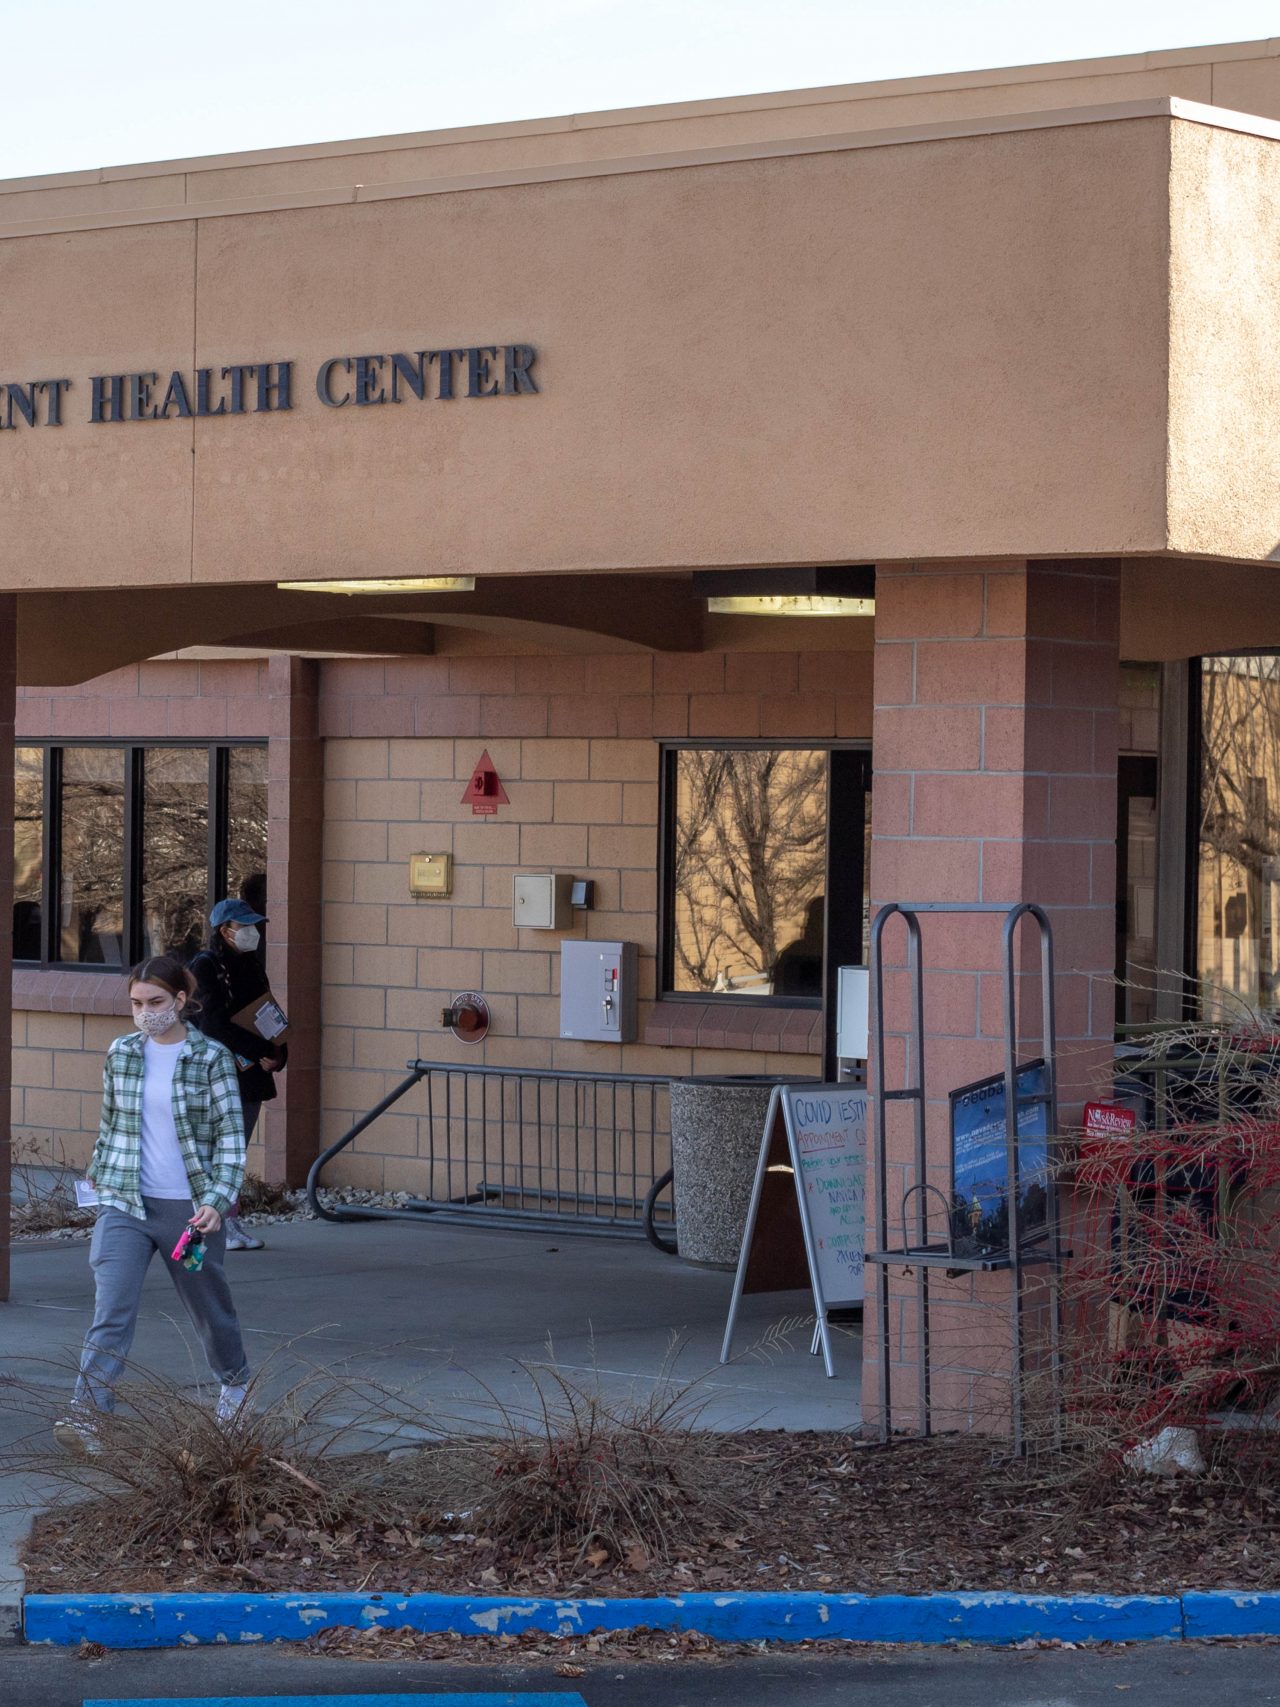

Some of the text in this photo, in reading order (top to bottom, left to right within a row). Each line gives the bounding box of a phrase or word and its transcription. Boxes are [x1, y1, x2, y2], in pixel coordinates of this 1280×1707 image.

[88, 361, 296, 425] HEALTH
[315, 342, 542, 409] CENTER
[795, 1098, 867, 1127] COVID TESTI
